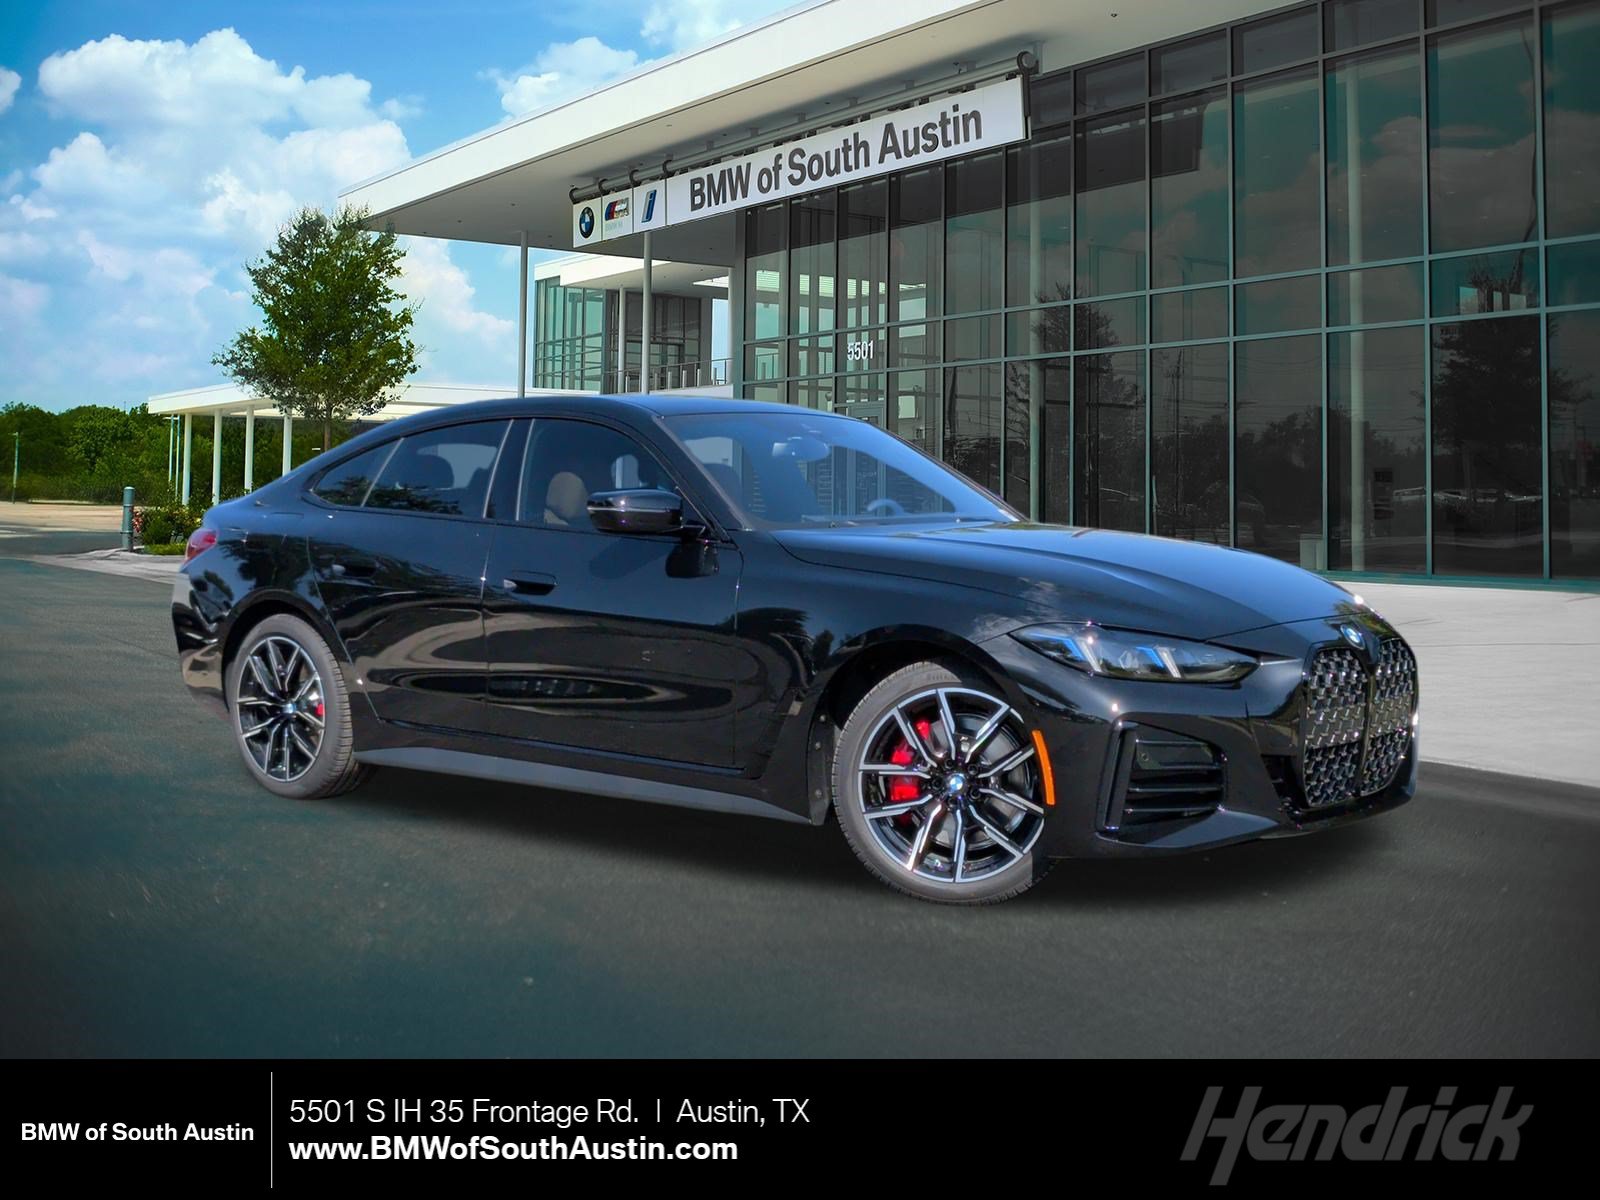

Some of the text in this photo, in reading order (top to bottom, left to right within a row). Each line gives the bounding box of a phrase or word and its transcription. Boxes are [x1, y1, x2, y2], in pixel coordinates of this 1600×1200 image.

[690, 162, 751, 212] BMW
[757, 153, 782, 194] of
[787, 131, 870, 186] South
[878, 104, 982, 164] Austin
[847, 340, 873, 360] 5501
